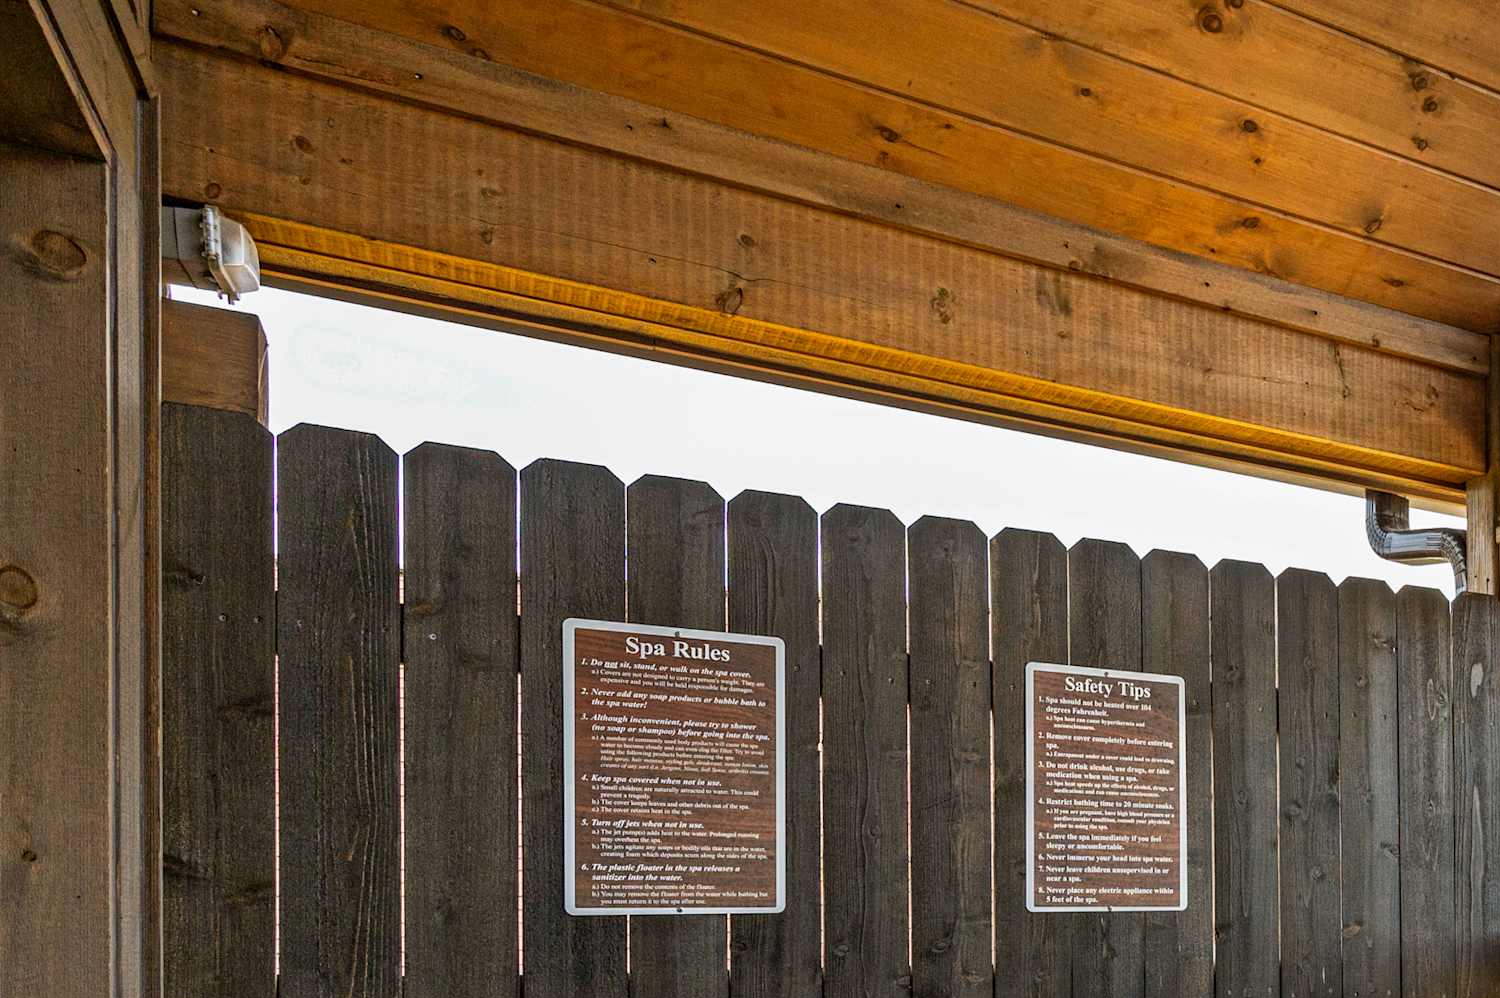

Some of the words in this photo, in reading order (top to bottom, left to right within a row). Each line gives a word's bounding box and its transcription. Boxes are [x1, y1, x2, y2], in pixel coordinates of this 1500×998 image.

[625, 637, 664, 659] Spa
[672, 641, 730, 660] Rules
[604, 659, 617, 667] not
[1064, 677, 1112, 697] Safety
[1118, 682, 1150, 700] Tips
[591, 688, 614, 696] Never
[669, 693, 701, 704] products
[714, 697, 738, 705] bubble
[607, 700, 619, 708] spa
[622, 700, 647, 708] water!
[592, 713, 627, 723] Although
[683, 719, 706, 728] please
[709, 721, 718, 729] try
[730, 722, 756, 730] shower
[592, 723, 605, 732] (no
[638, 726, 676, 736] shampoo)
[678, 728, 701, 737] before
[703, 730, 723, 739] going
[591, 773, 610, 783] Keep
[629, 775, 658, 783] covered
[613, 820, 625, 828] off
[626, 820, 639, 828] jets
[609, 864, 634, 872] plastic
[637, 864, 663, 872] floater
